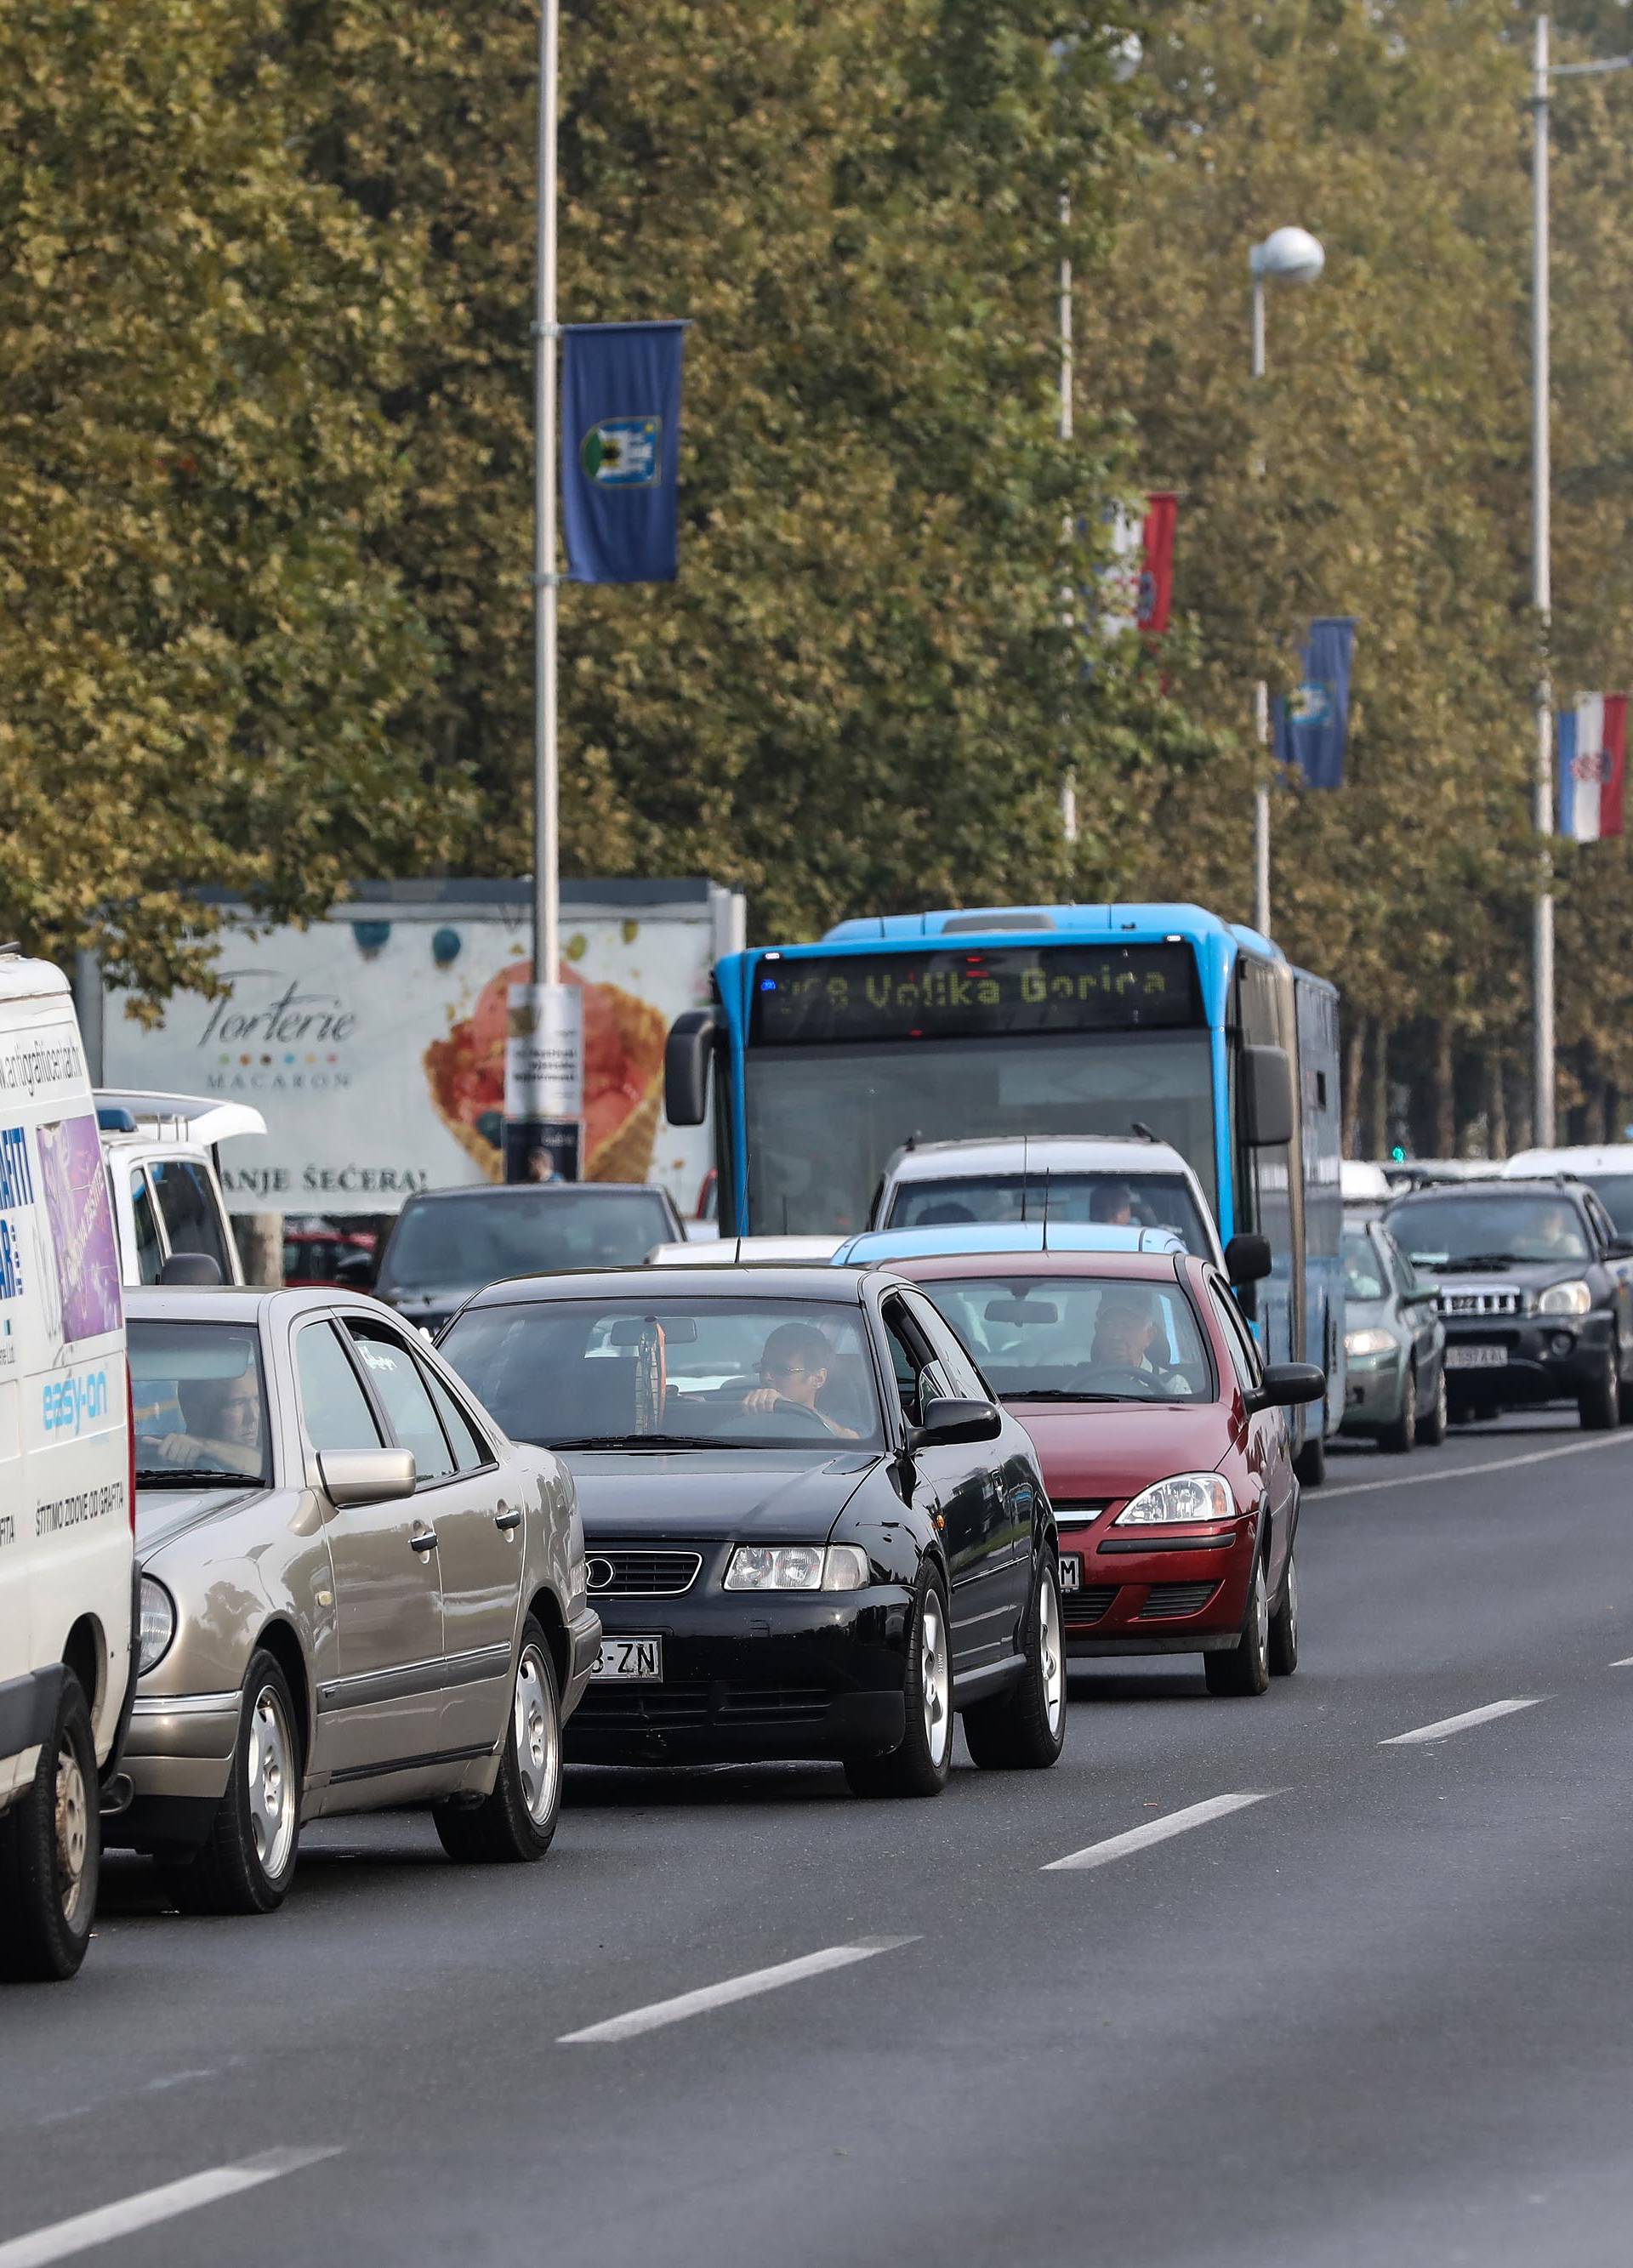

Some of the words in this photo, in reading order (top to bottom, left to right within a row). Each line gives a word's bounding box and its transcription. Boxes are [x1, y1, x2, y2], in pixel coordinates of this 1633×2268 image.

[197, 969, 356, 1049] Torterie
[207, 1073, 352, 1091] MACARON
[43, 1371, 107, 1435] easy-on
[65, 1492, 88, 1526] ZIDOVE
[88, 1490, 98, 1519] OD
[99, 1481, 124, 1515] GRAFITA
[1060, 1560, 1076, 1586] M
